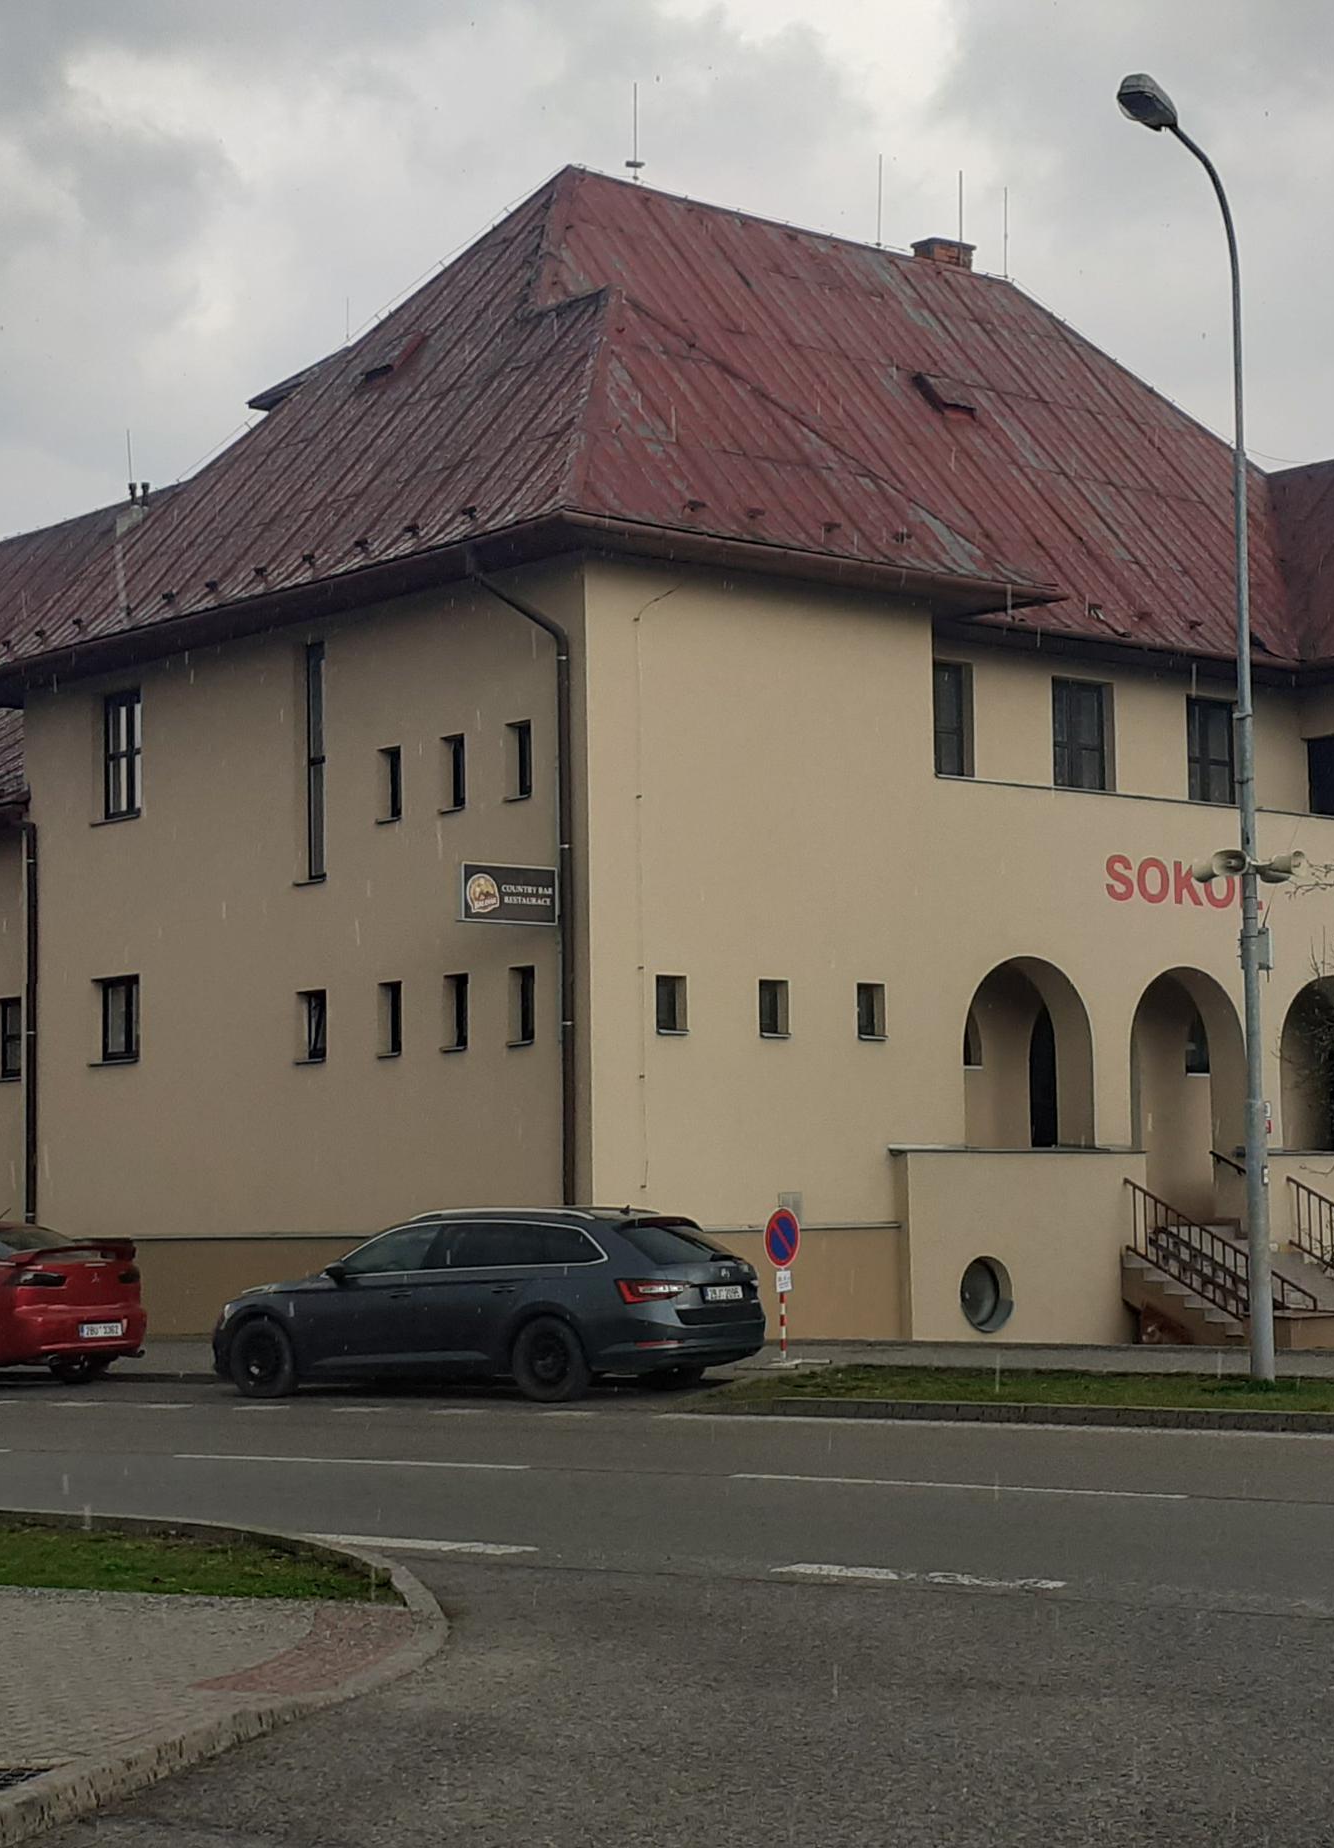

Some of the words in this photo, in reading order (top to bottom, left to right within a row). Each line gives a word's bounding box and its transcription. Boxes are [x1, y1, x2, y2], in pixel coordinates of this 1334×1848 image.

[1106, 854, 1264, 911] SOKO
[501, 884, 537, 894] COUNTRY
[538, 886, 553, 895] BAR
[504, 896, 551, 906] RESTAURACE
